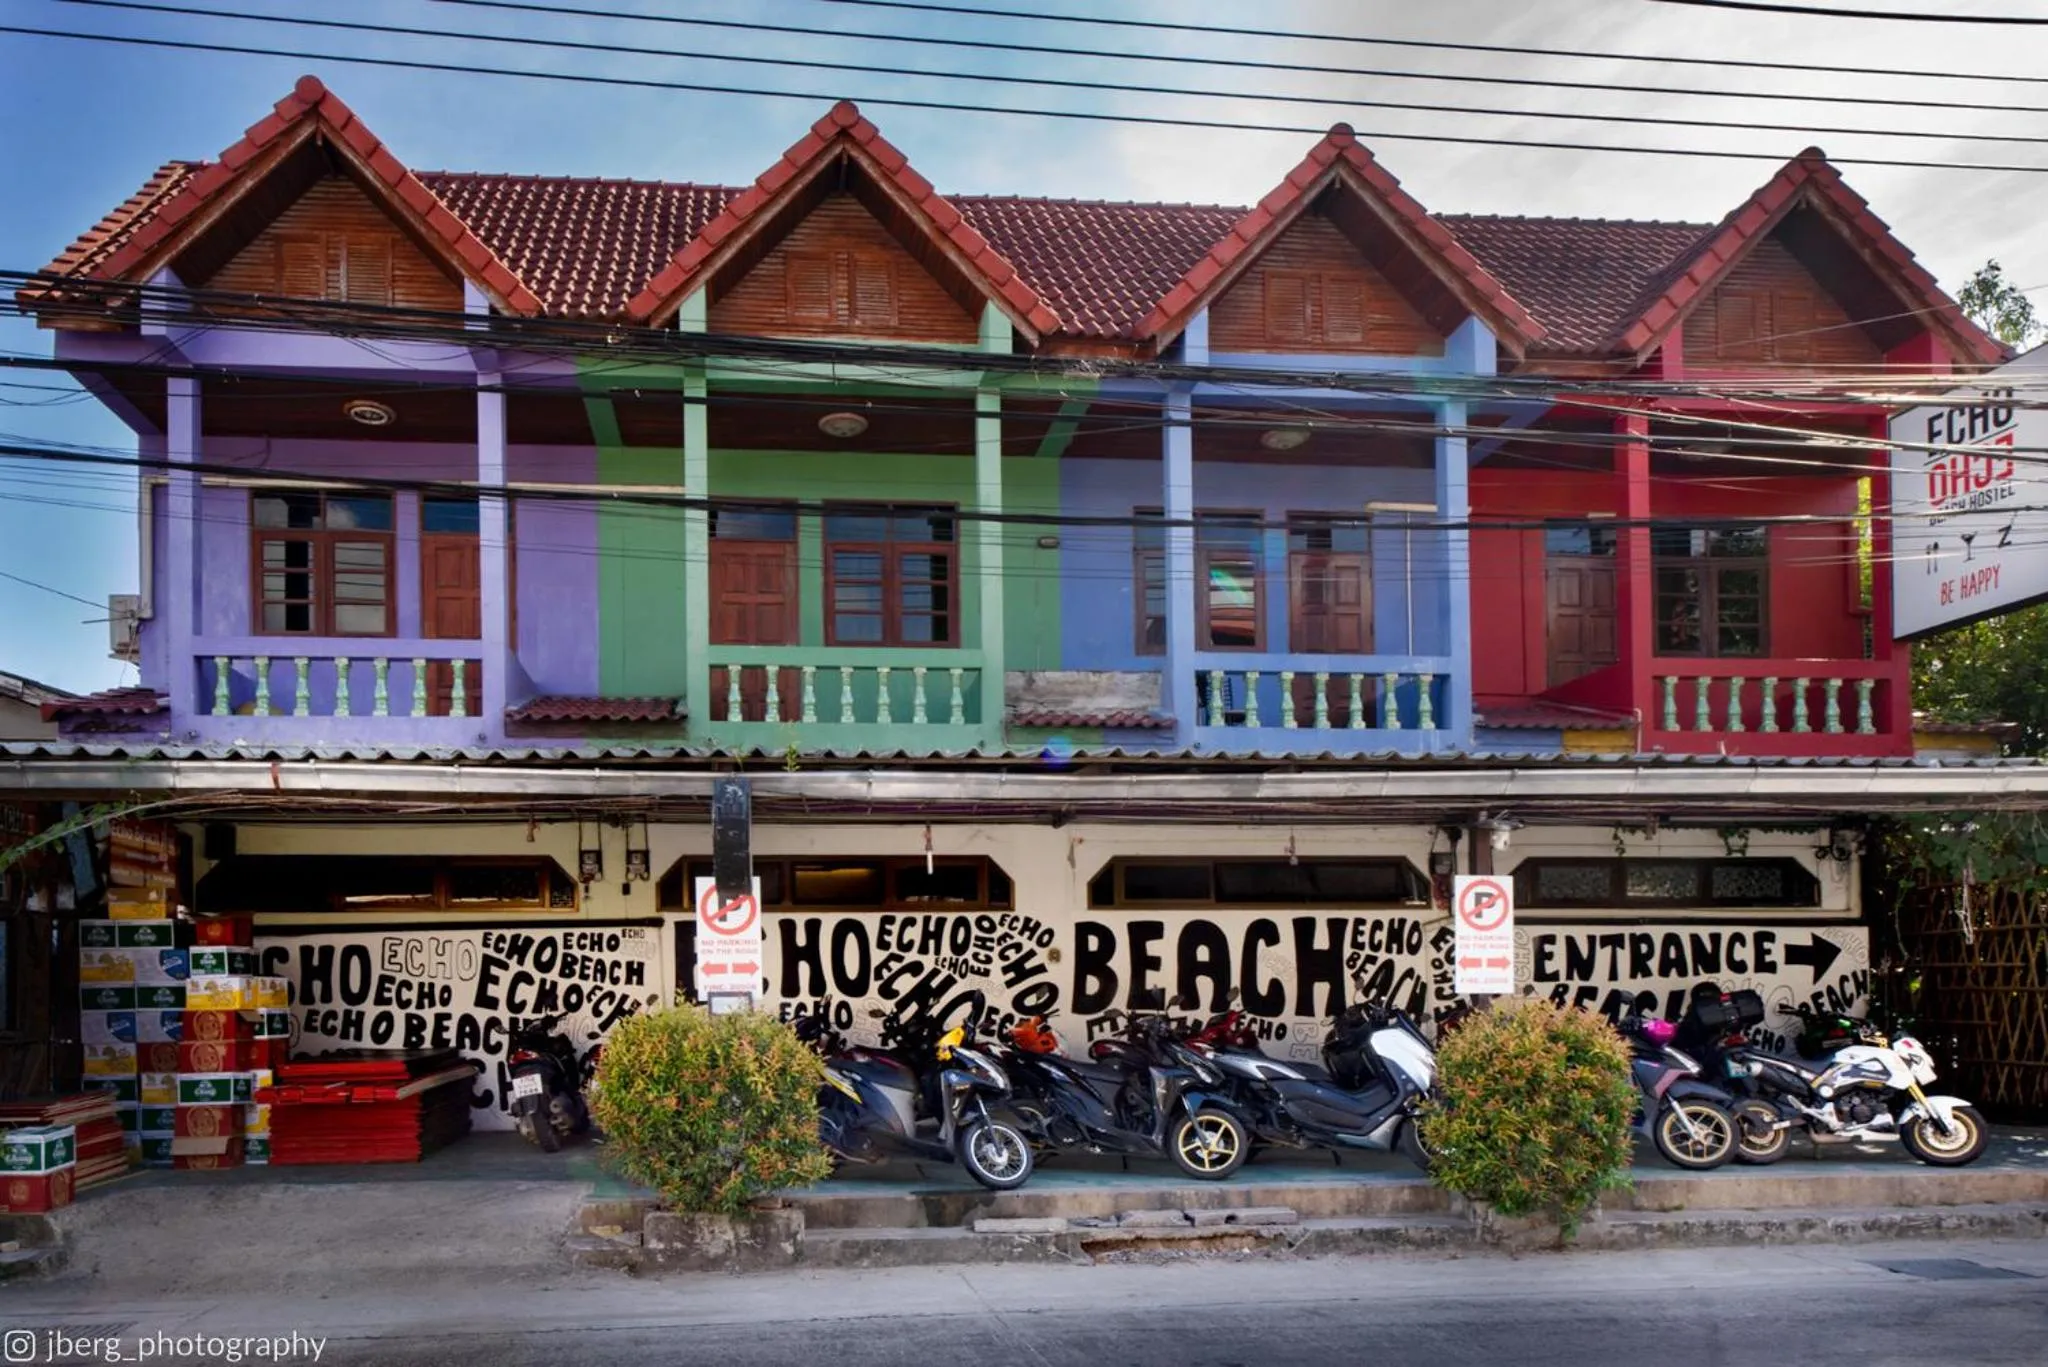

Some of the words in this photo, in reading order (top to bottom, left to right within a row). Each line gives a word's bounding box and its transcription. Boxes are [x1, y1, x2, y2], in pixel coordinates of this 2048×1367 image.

[1928, 387, 2012, 458] ECHO
[1969, 486, 2015, 512] HOSTEL
[1941, 581, 1955, 607] BE
[1960, 565, 2000, 599] HAPPY
[482, 931, 558, 974] ECHO
[563, 932, 620, 952] ECHO
[876, 915, 971, 956] ECHO
[969, 915, 997, 977] ECHO
[998, 914, 1054, 948] ECHO
[1351, 917, 1422, 955] ECHO
[262, 943, 372, 1007] CHO
[381, 937, 479, 981] ECHO
[558, 952, 644, 986] BEACH
[675, 917, 870, 1007] EHO
[934, 957, 968, 979] ECHO
[996, 932, 1059, 1016] ECHO
[1071, 917, 1349, 1018] BEACH
[1532, 931, 1777, 982] ENTRANCE
[373, 974, 452, 1010] ECHO
[473, 953, 585, 1014] ECHO
[1346, 951, 1427, 1023] BEACH
[304, 1009, 394, 1045] ECHO
[586, 985, 645, 1033] ECH
